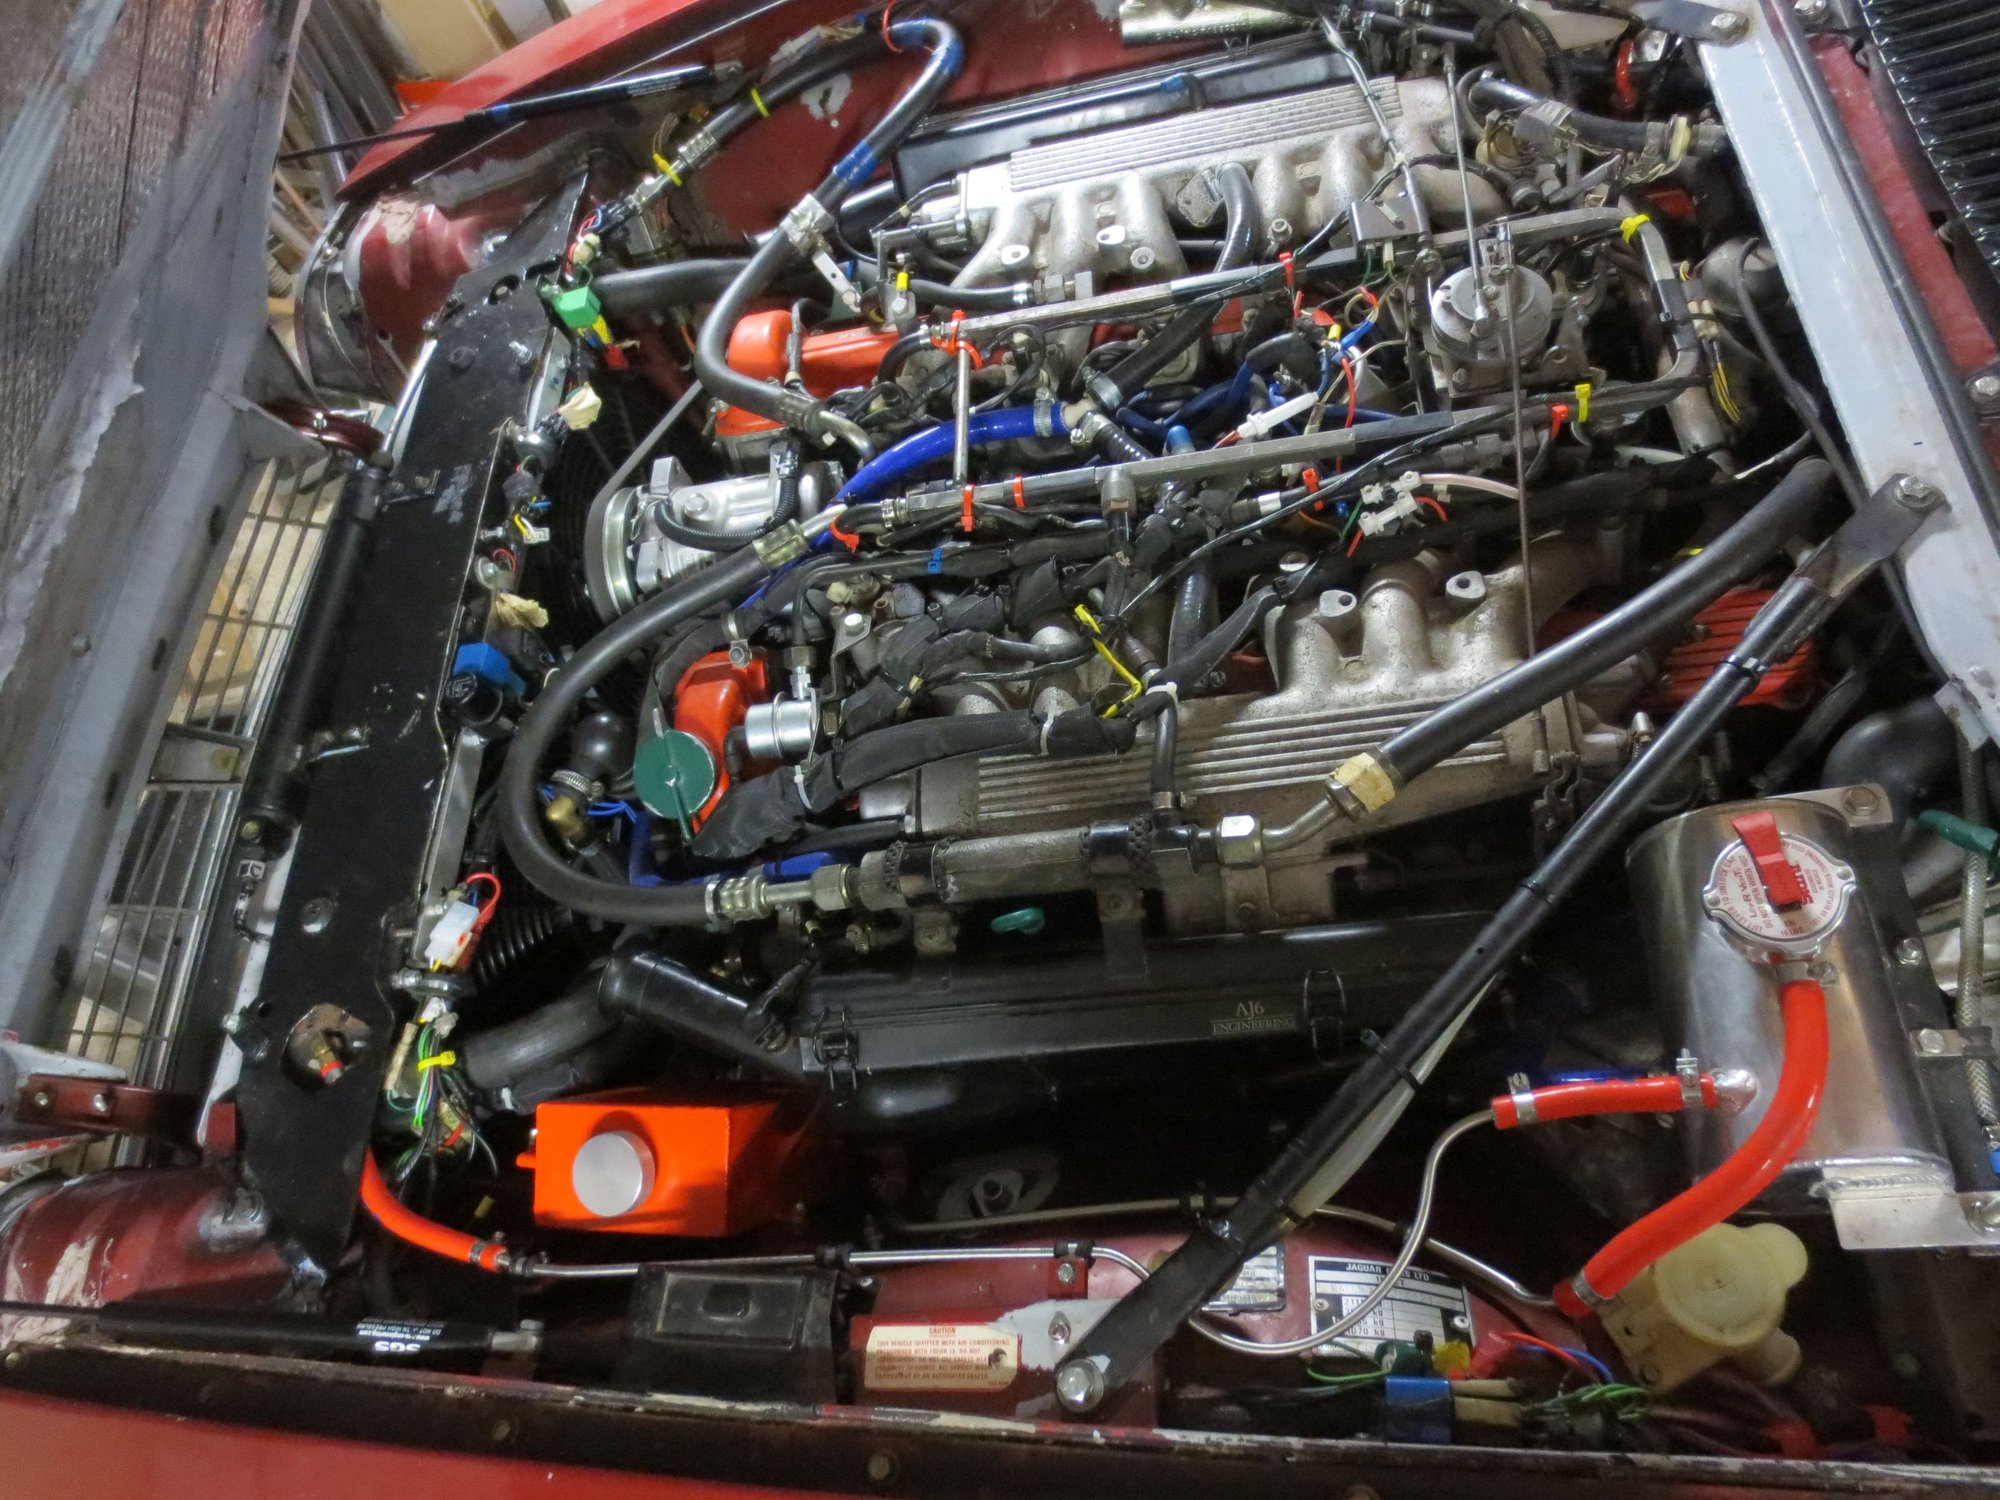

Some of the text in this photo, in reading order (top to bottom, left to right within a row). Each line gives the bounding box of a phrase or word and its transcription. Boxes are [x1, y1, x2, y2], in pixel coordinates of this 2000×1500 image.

[1236, 1001, 1265, 1020] AJ6
[1212, 1018, 1296, 1033] ENGINEERING
[1345, 1263, 1382, 1274] JAGUAR
[1414, 1272, 1430, 1281] LTD
[374, 1340, 421, 1352] SGS
[969, 1338, 1010, 1346] CONDITIONING
